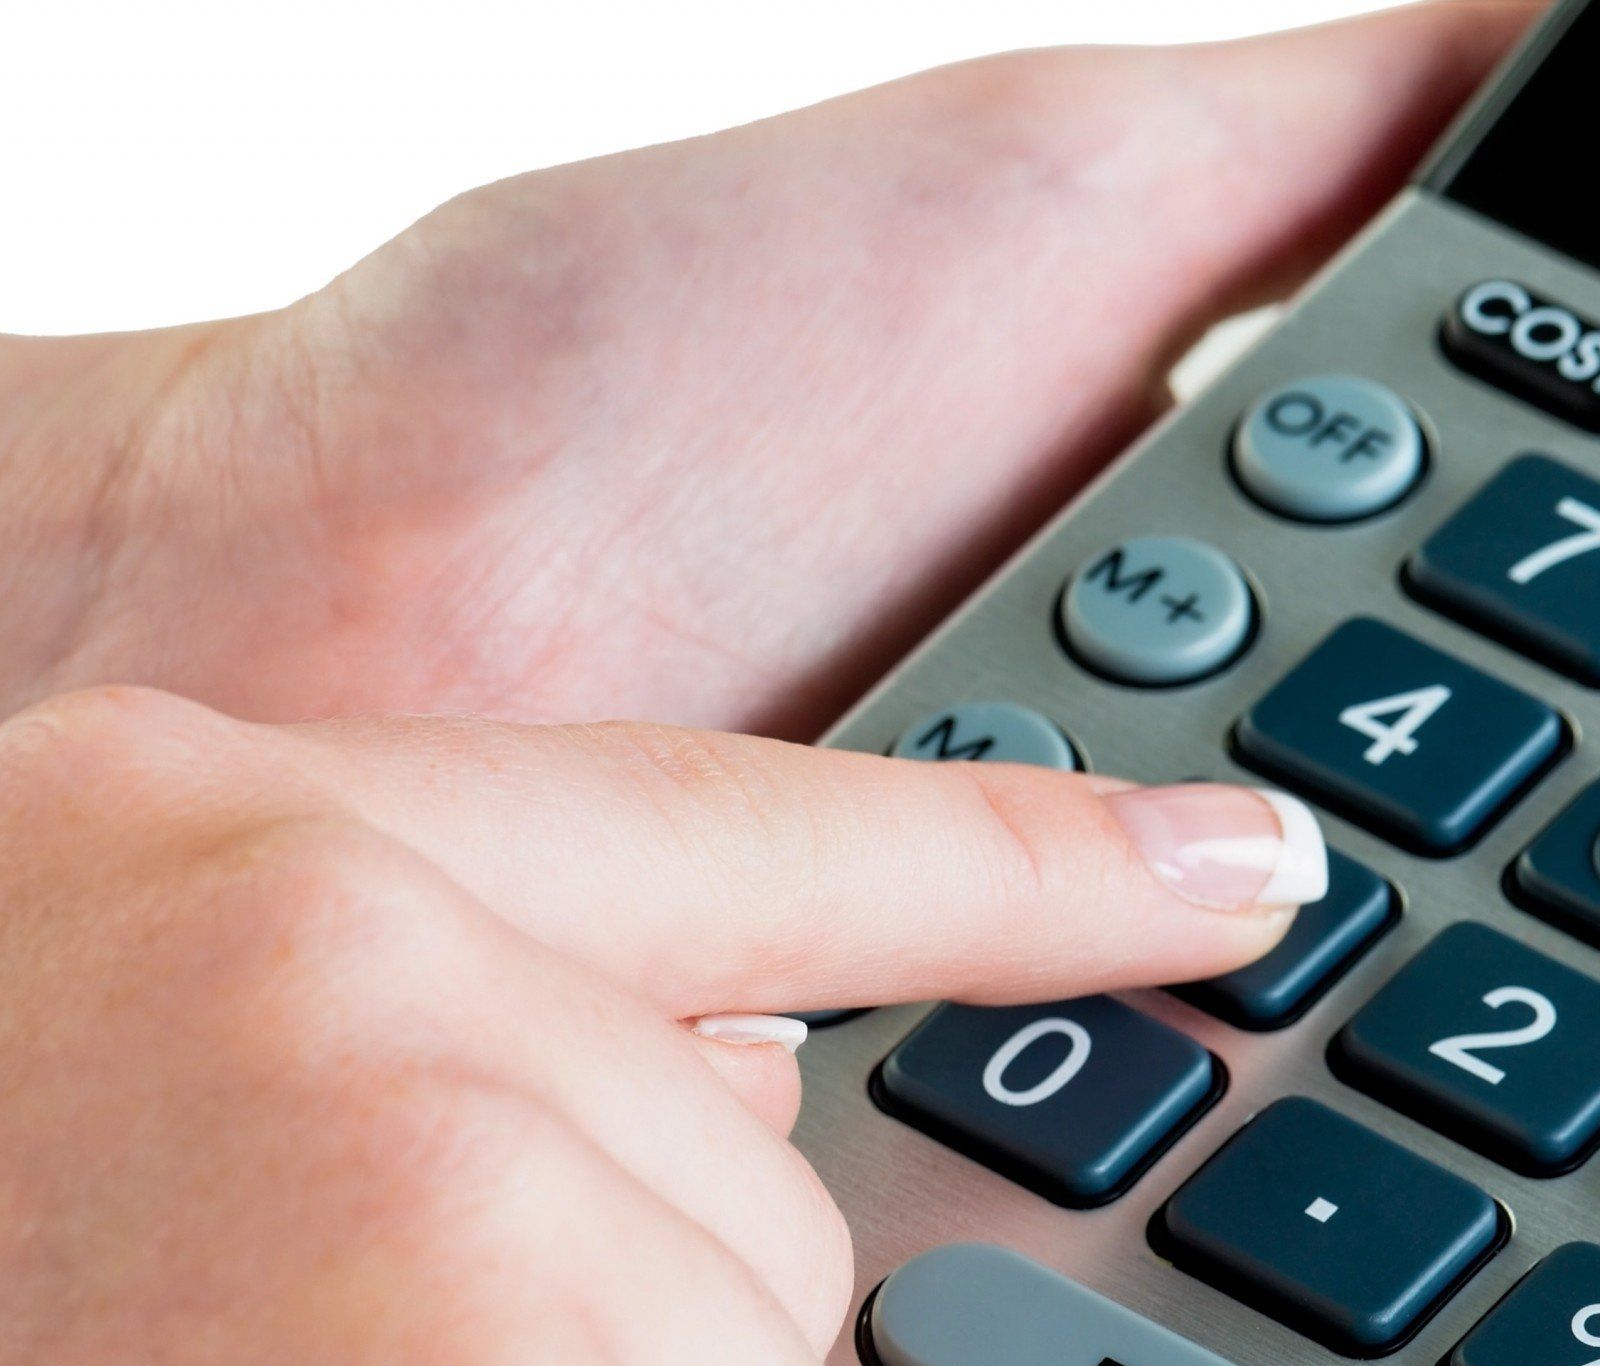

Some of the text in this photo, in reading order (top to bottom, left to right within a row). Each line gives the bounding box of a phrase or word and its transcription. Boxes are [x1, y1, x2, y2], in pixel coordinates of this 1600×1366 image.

[1263, 390, 1394, 466] OFF
[1085, 545, 1205, 626] M+
[914, 714, 998, 763] M
[1338, 683, 1452, 766] 4
[982, 1017, 1092, 1106] 0
[1427, 985, 1558, 1086] 2
